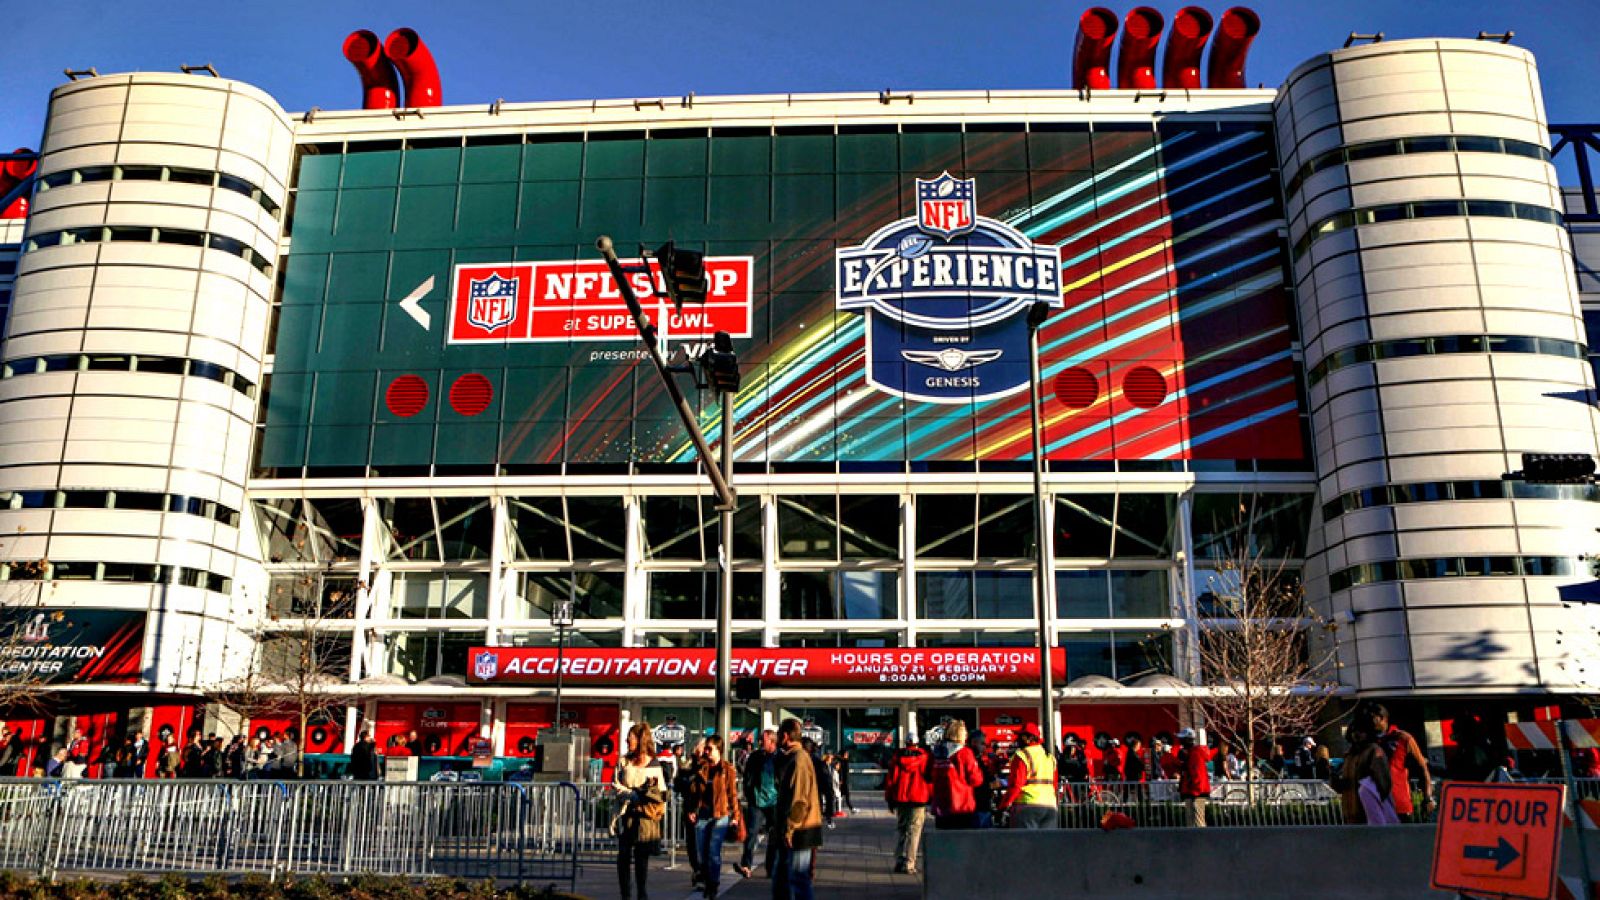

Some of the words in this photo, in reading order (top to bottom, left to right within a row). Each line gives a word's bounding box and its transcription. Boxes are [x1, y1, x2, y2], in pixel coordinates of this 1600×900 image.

[923, 201, 970, 230] NFL
[844, 254, 1057, 292] EXPERIENCE
[544, 272, 621, 300] NFL
[631, 269, 738, 298] SP
[473, 298, 510, 323] NFL
[563, 318, 581, 331] at
[587, 314, 650, 330] SUPE
[664, 313, 715, 329] OWL
[590, 348, 656, 361] presente
[925, 376, 981, 388] GENESIS
[0, 646, 105, 658] REDITATION
[831, 653, 894, 664] HOURS
[900, 653, 924, 664] OF
[931, 653, 1035, 664] OPERATION
[504, 657, 701, 675] ACCREDITATION
[848, 665, 907, 673] JANUARY
[911, 665, 925, 673] 21
[937, 665, 1006, 673] FEBRUARY
[1010, 665, 1017, 673] 3
[1452, 798, 1548, 827] DETOUR
